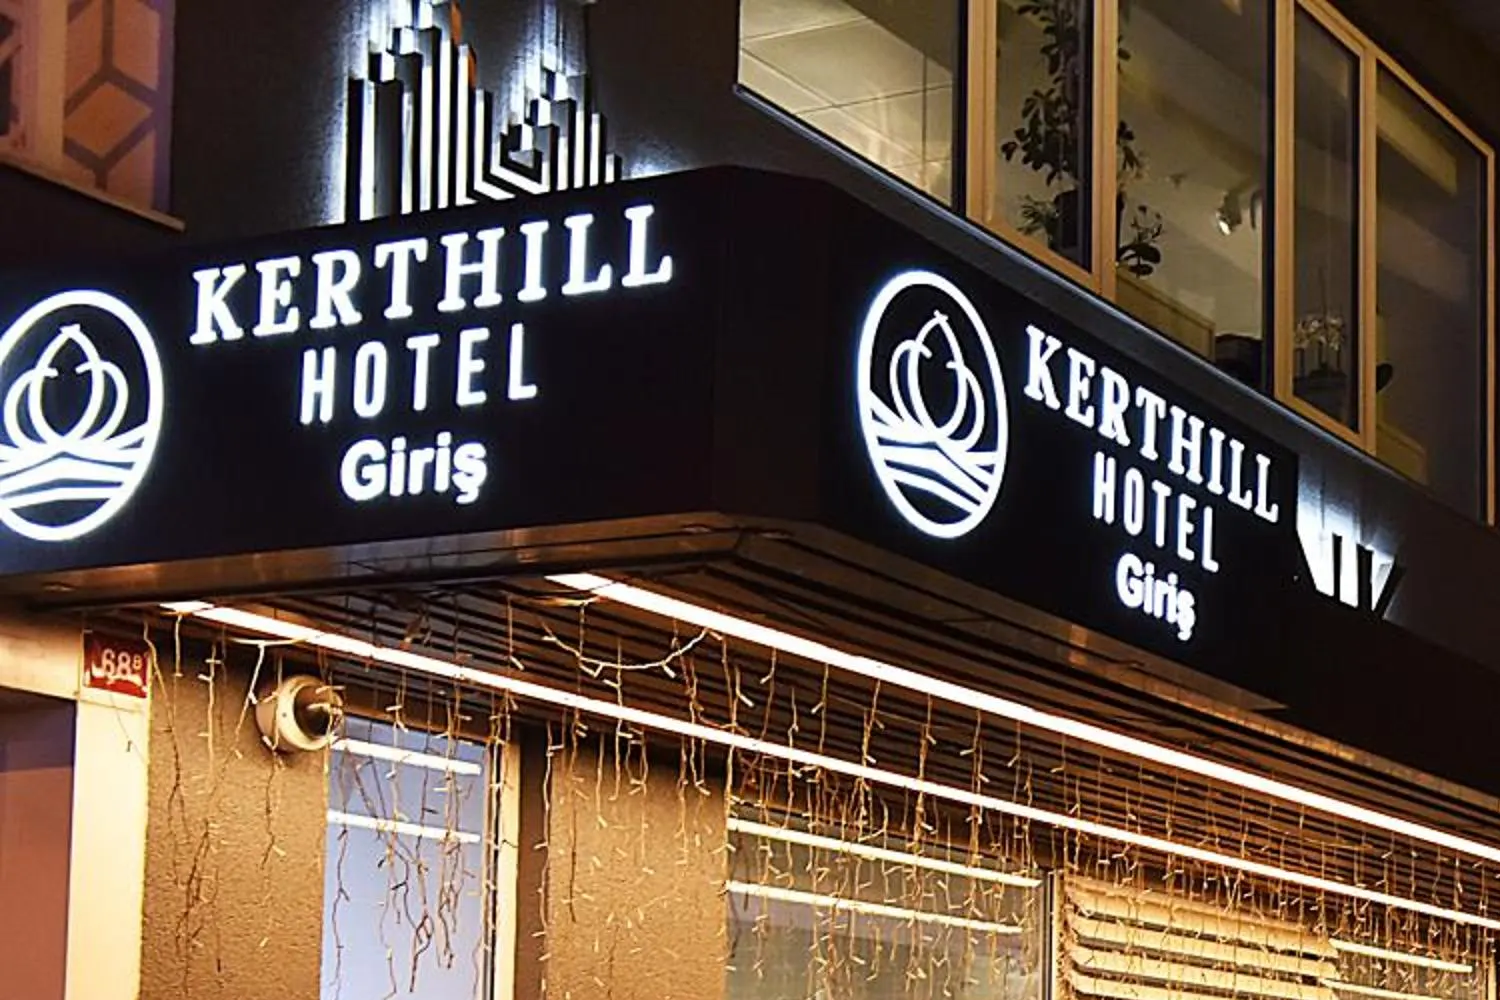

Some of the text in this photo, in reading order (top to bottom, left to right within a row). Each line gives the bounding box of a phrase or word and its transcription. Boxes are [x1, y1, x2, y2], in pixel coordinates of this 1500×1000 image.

[189, 204, 673, 345] KERTHILL
[299, 322, 538, 426] HOTEL
[1023, 324, 1279, 524] KERTHILL
[340, 431, 488, 505] Giriş
[1093, 451, 1219, 574] HOTEL
[1115, 552, 1196, 642] Giriş
